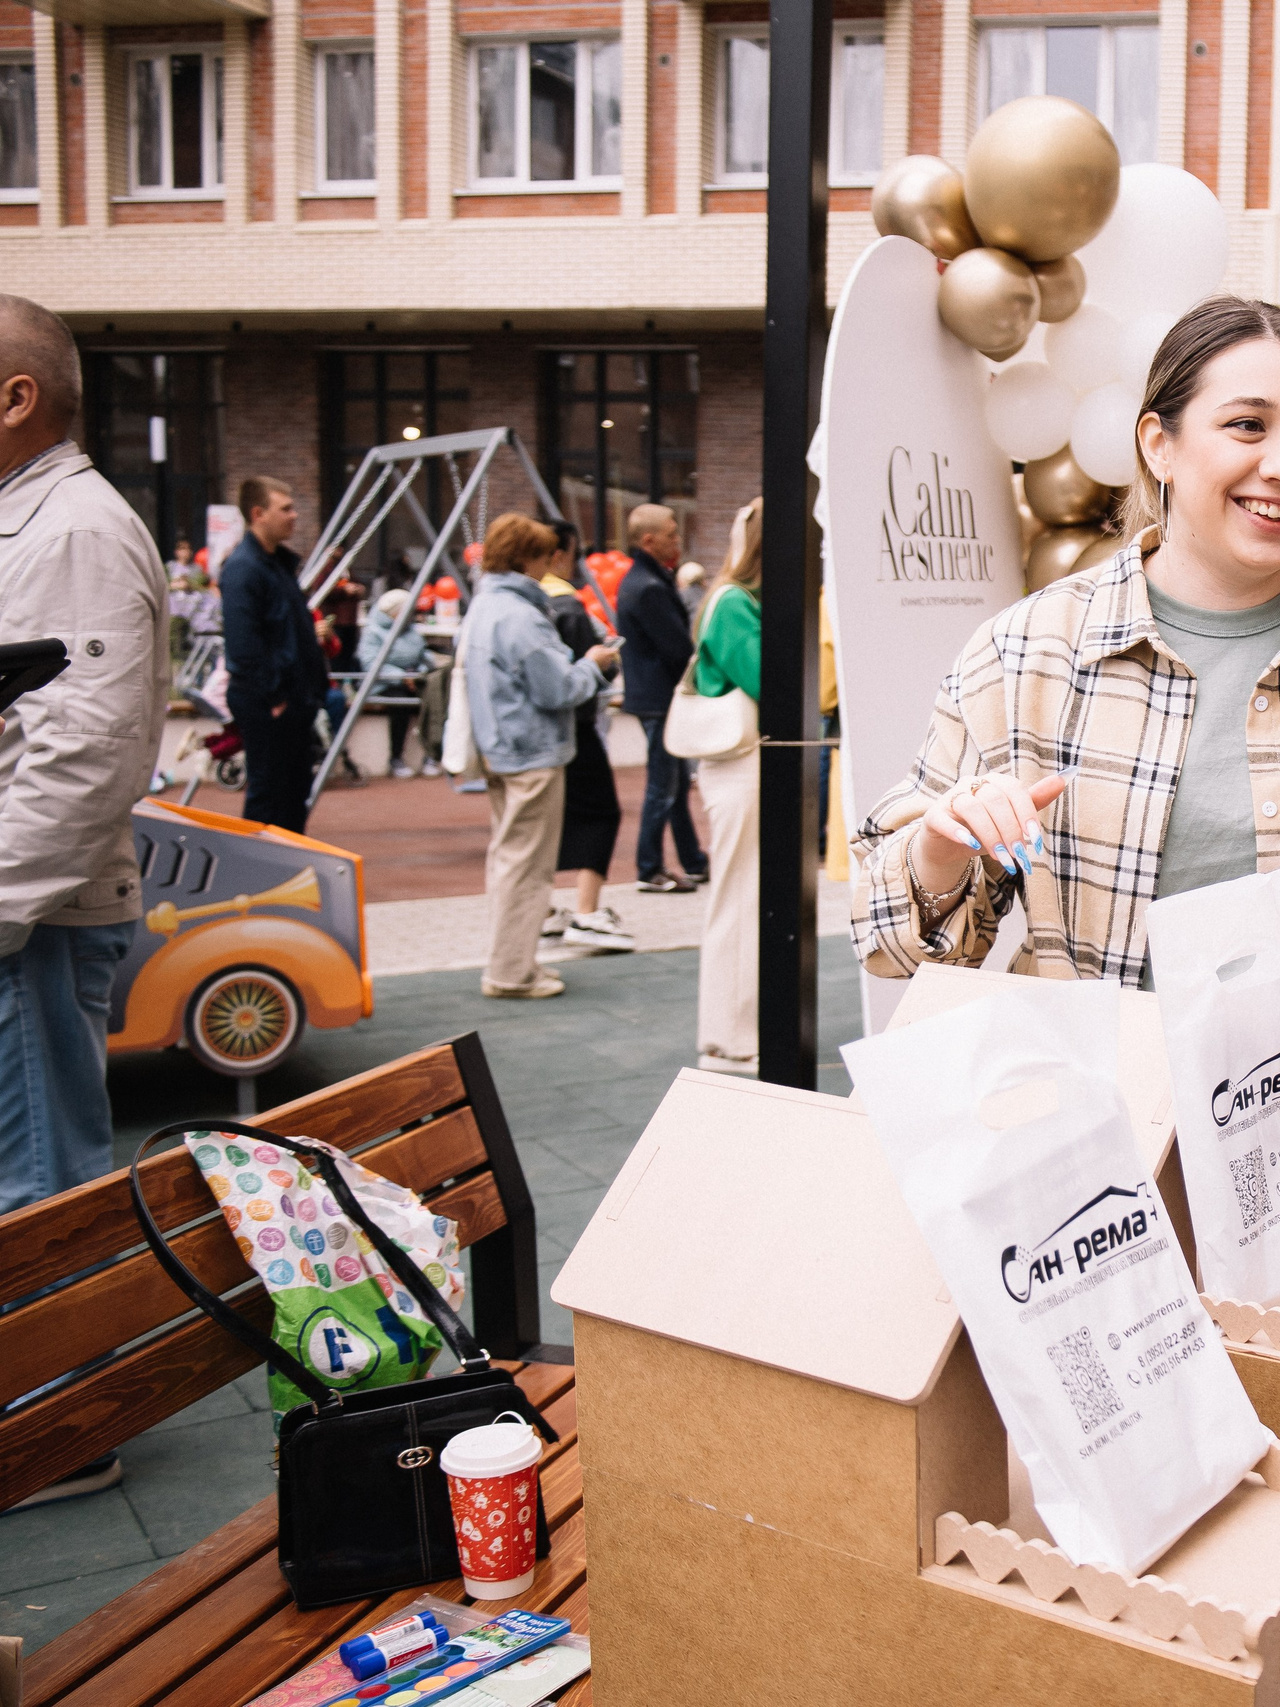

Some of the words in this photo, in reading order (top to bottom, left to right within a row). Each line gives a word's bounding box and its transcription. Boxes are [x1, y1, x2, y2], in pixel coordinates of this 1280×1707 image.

[888, 445, 979, 540] Calin
[1137, 1355, 1146, 1368] 8
[1145, 1342, 1167, 1367] (3952)
[1164, 1321, 1197, 1351] 622-853
[1145, 1372, 1154, 1386] 8
[1152, 1361, 1171, 1385] (902)
[1168, 1337, 1206, 1370] 516-81-53
